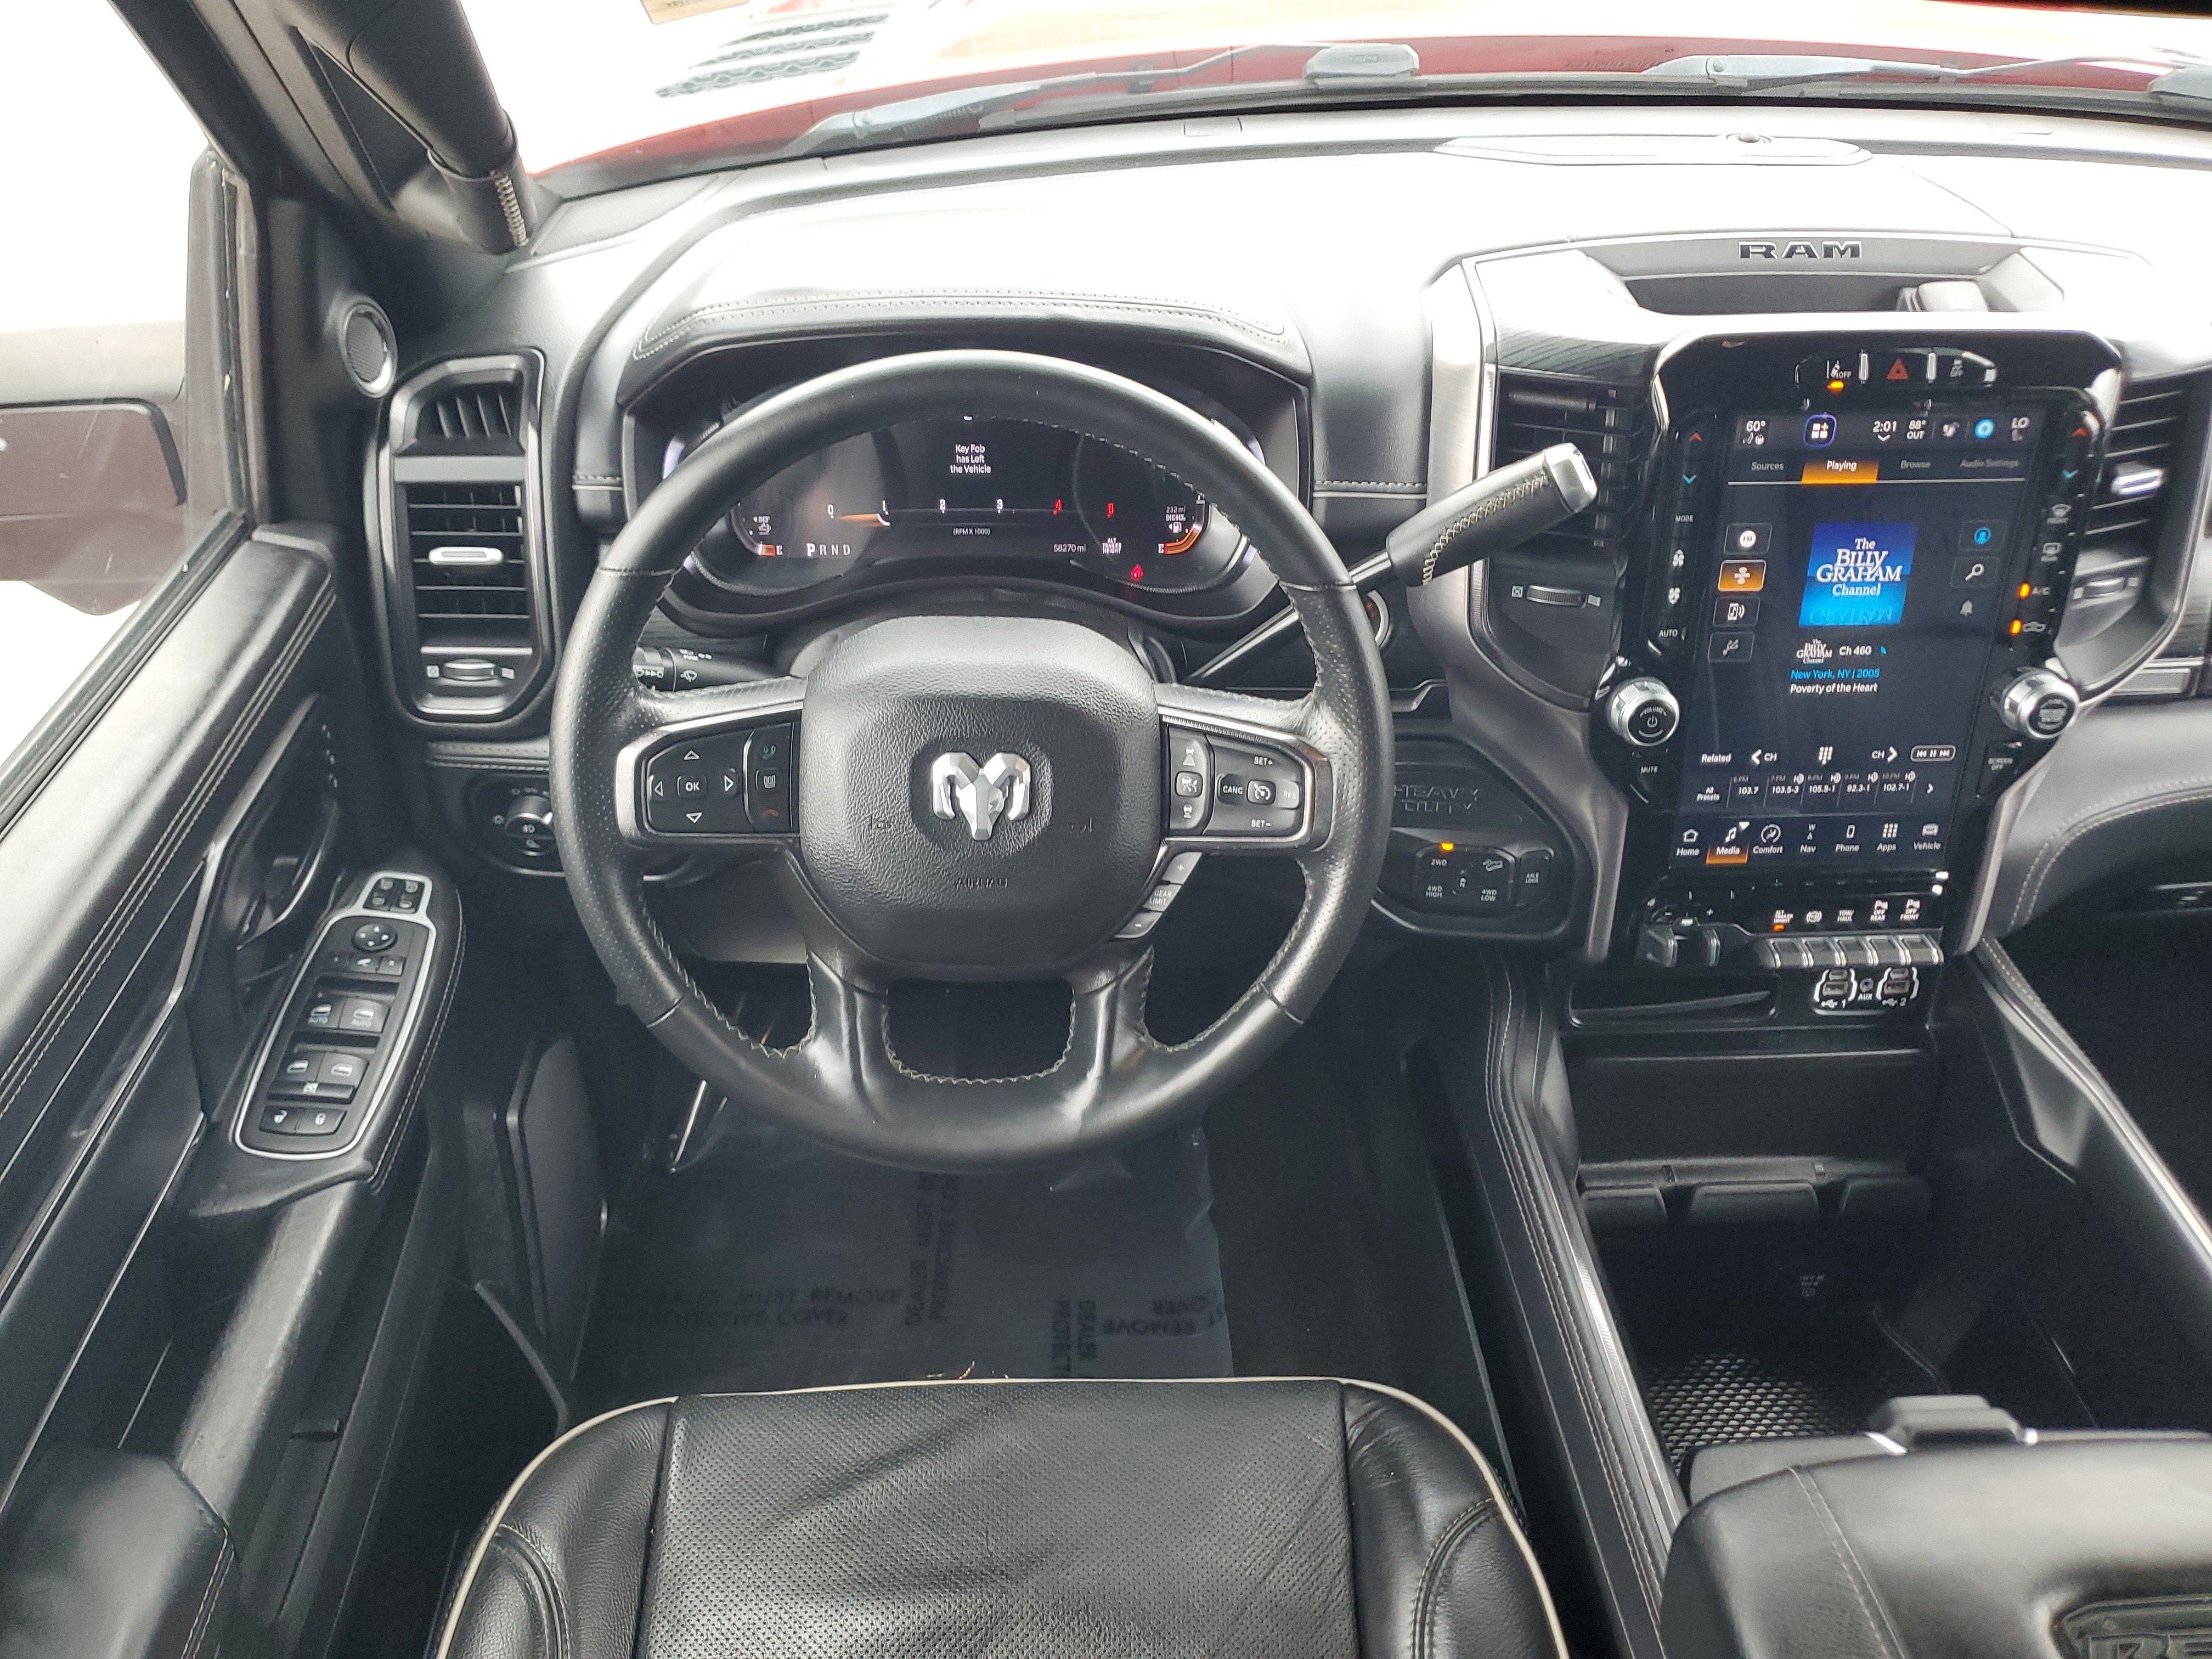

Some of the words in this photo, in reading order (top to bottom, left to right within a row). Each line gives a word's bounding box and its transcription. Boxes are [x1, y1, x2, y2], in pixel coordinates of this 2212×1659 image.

[1739, 241, 1862, 259] RAM
[1746, 420, 1766, 432] 60°
[1872, 420, 1897, 432] 2:01
[2011, 417, 2029, 428] LO
[1906, 431, 1925, 439] OUT
[955, 444, 969, 454] Key
[970, 444, 985, 454] Fob
[956, 454, 969, 464] has
[970, 455, 985, 464] Left
[950, 465, 963, 473] the
[964, 464, 991, 473] Vehicle
[1751, 461, 1784, 471] Sources
[1826, 460, 1857, 472] Playing
[1900, 460, 1931, 469] Browse
[939, 499, 946, 510] 2
[996, 499, 1003, 510] 3
[953, 527, 968, 536] (RPM
[974, 527, 991, 536] 1000)
[1855, 537, 1876, 550] The
[806, 543, 816, 557] P
[819, 544, 827, 556] R
[831, 544, 839, 556] N
[843, 544, 850, 556] D
[1836, 549, 1889, 572] BILLY
[1816, 564, 1903, 583] GRAHAM
[1832, 583, 1881, 596] Channel
[1658, 629, 1678, 637] AUTO
[1839, 645, 1852, 656] Ch
[1854, 645, 1872, 656] 460
[1791, 669, 1810, 680] New
[1838, 668, 1851, 679] NY
[1790, 684, 1824, 695] Poverty
[1826, 682, 1836, 693] of
[1837, 682, 1852, 693] the
[1853, 682, 1878, 693] Heart
[1702, 753, 1731, 764] Related
[1764, 752, 1778, 762] CH
[1872, 749, 1886, 759] CH
[1640, 766, 1658, 774] MUTE
[686, 781, 701, 792] OK
[1222, 785, 1243, 795] CANC
[1753, 845, 1783, 854] Comfort
[1800, 844, 1816, 853] Nav
[1836, 843, 1860, 852] Phone
[1877, 842, 1897, 853] Apps
[1913, 840, 1942, 850] Vehicle
[1677, 847, 1700, 856] Home
[1716, 846, 1740, 855] Media
[1427, 884, 1443, 893] 4WD
[1899, 913, 1920, 921] FRONT
[1841, 998, 1846, 1009] 1
[1899, 997, 1907, 1007] 2
